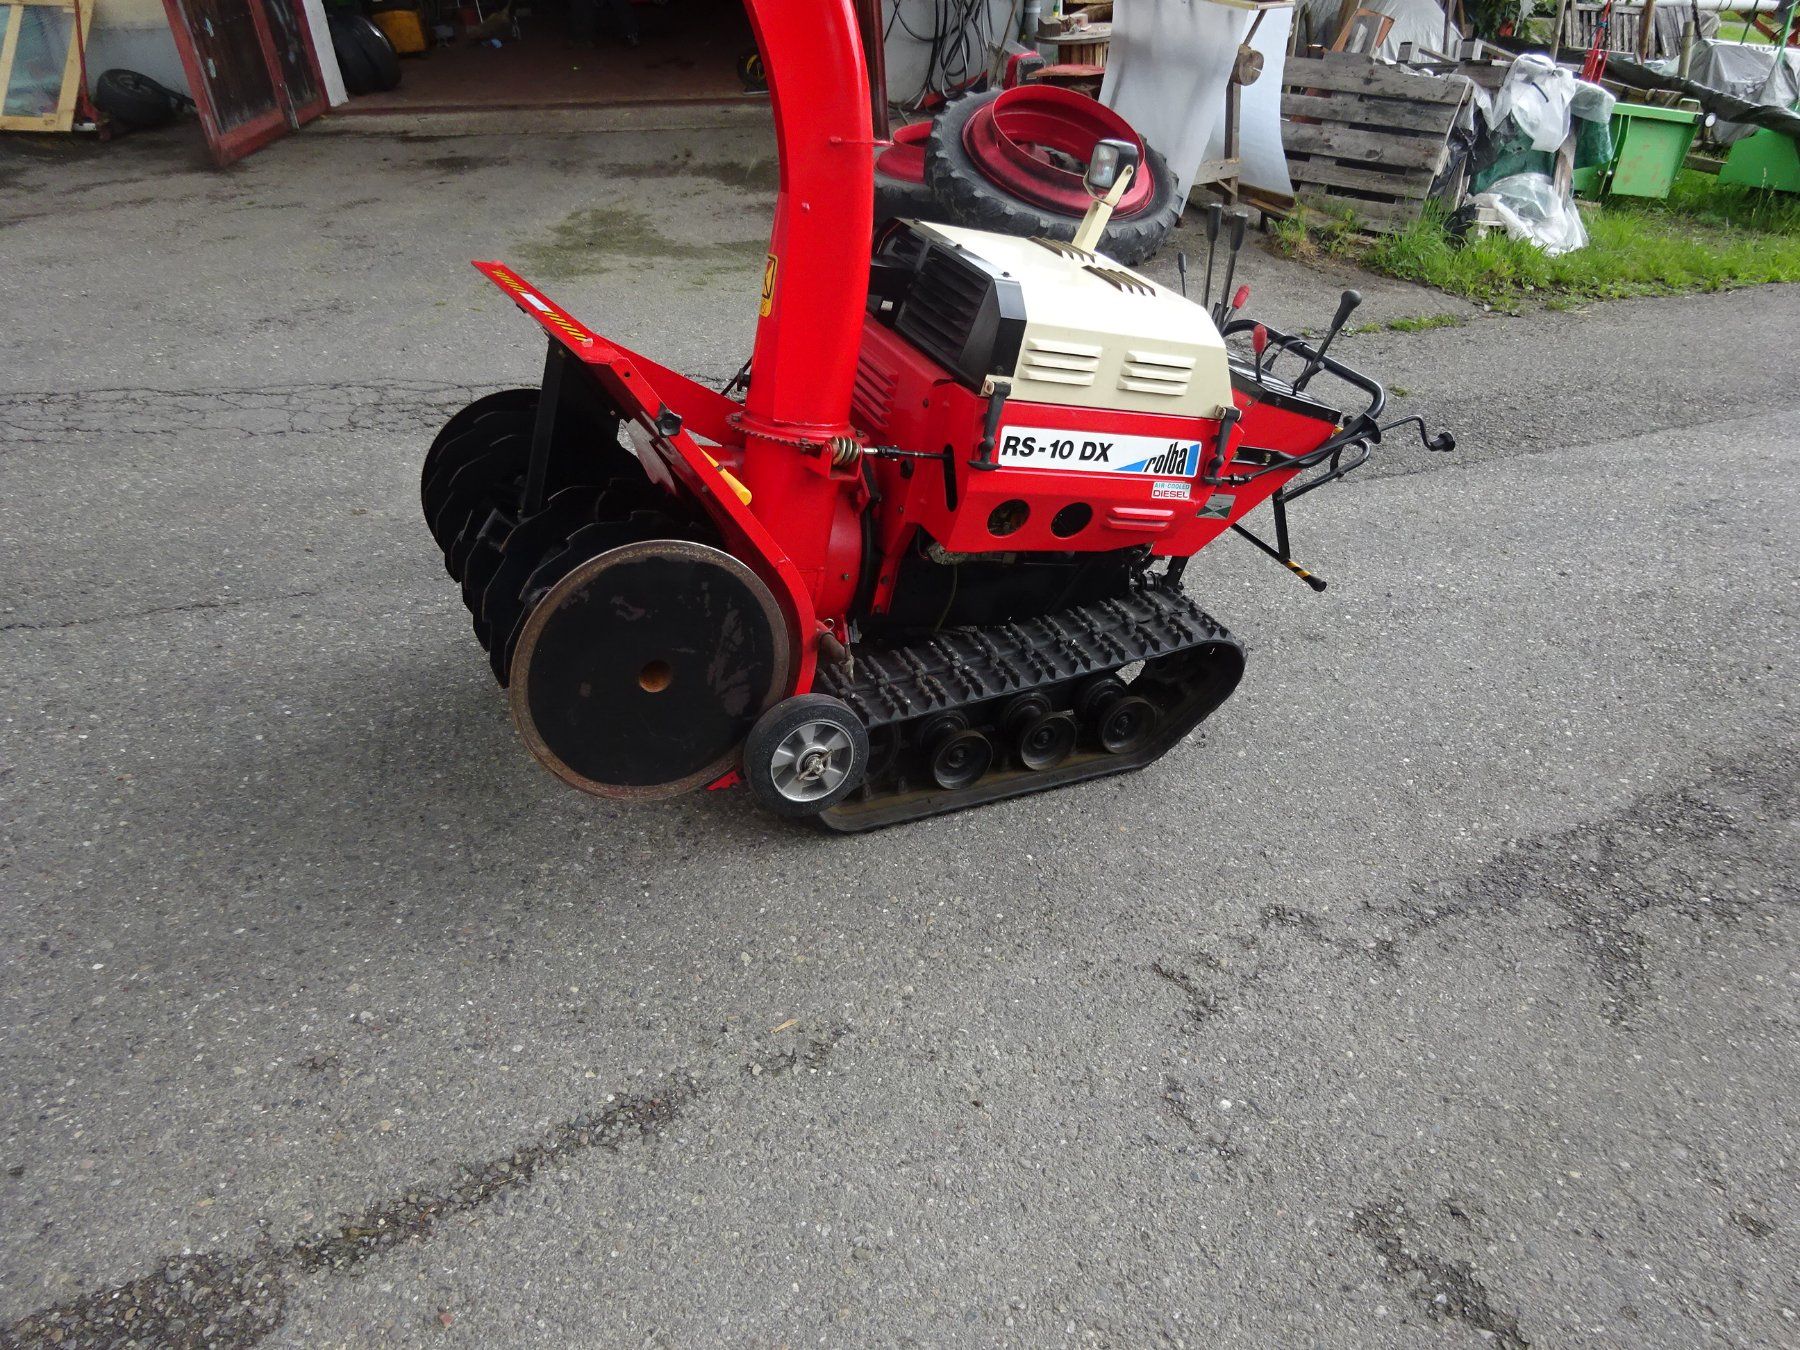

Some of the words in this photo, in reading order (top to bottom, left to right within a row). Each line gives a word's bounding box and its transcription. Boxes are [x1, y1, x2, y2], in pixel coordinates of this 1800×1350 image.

[1002, 435, 1074, 460] RS-10
[1079, 441, 1114, 463] DX
[1143, 441, 1188, 475] rolba
[1153, 489, 1188, 498] DIESEL
